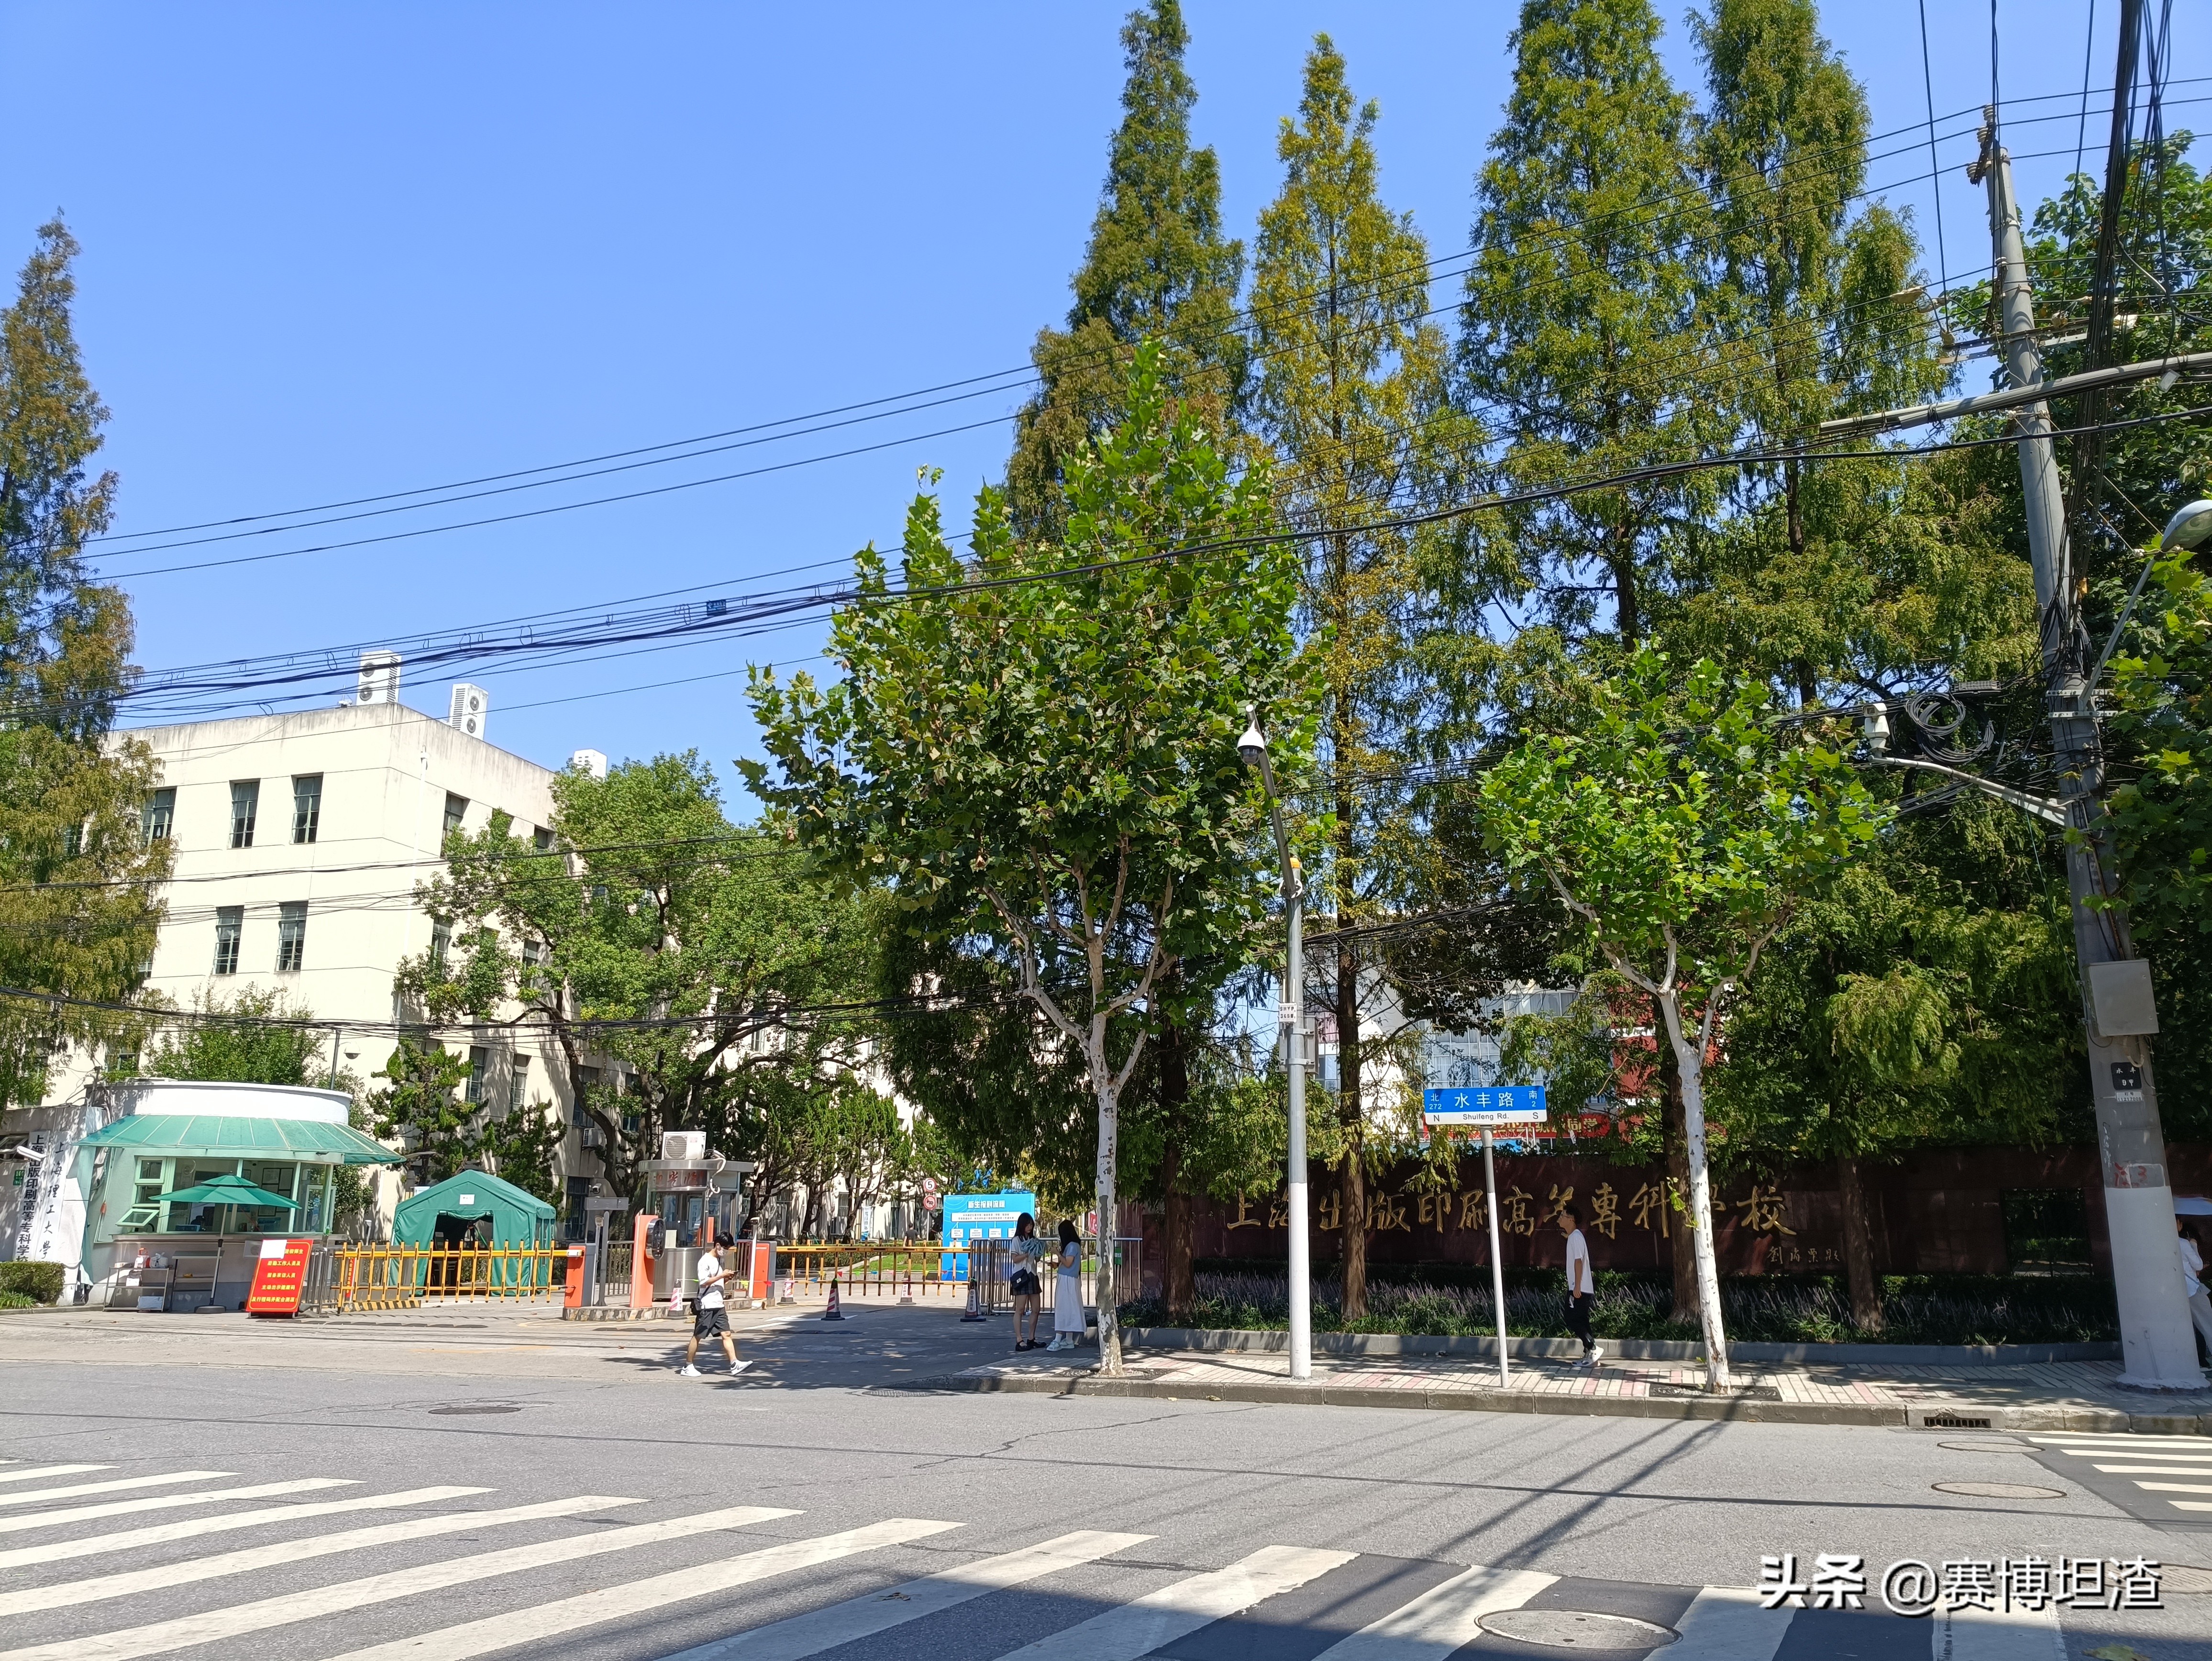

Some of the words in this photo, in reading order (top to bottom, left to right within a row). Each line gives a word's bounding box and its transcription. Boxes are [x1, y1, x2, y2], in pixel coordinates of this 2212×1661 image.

[1430, 1093, 1439, 1102] 北
[1454, 1092, 1515, 1108] 水丰路
[1528, 1091, 1537, 1100] 南
[1433, 1114, 1440, 1122] N
[1462, 1113, 1494, 1121] Shuifeng
[1532, 1112, 1538, 1120] S
